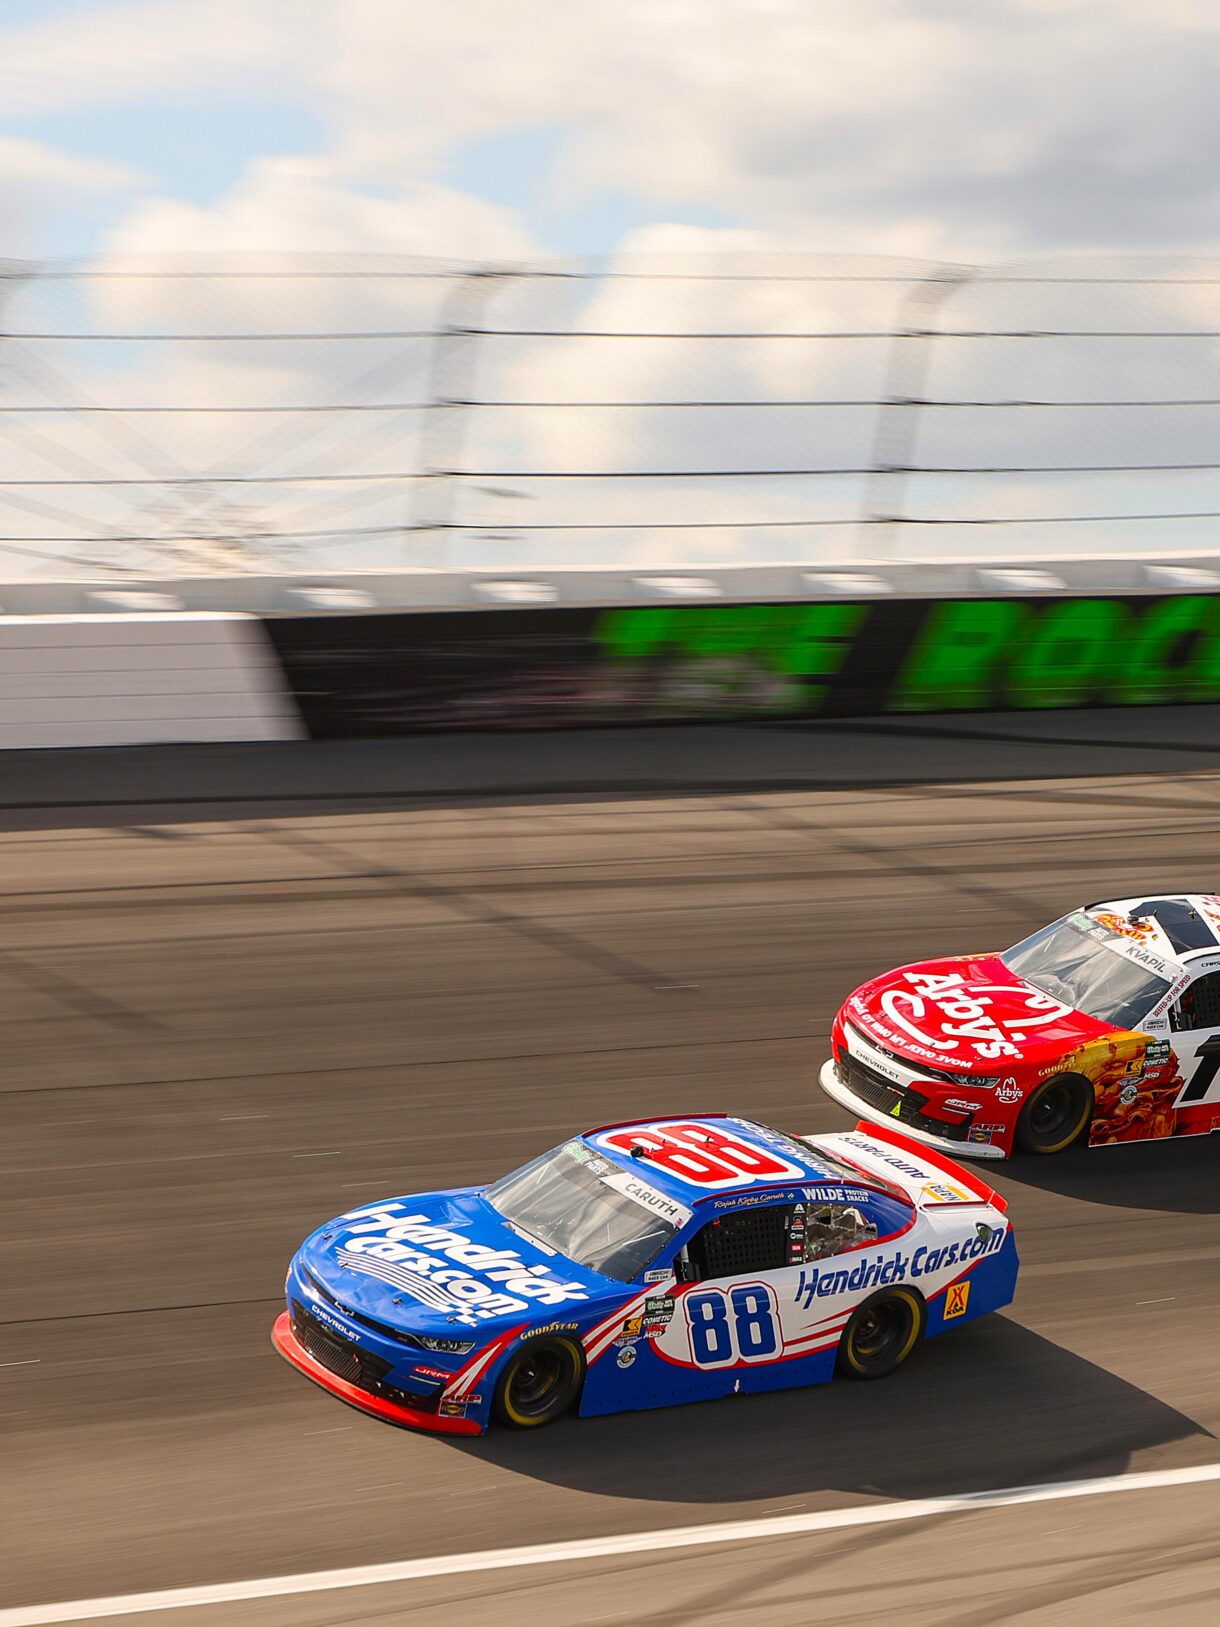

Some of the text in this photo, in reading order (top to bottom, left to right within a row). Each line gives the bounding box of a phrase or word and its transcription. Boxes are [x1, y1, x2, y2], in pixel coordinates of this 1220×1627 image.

[1129, 899, 1220, 956] 1
[1126, 946, 1167, 973] KVAPIL
[902, 971, 1027, 1059] Arby's
[855, 1049, 901, 1080] CHEVROLET
[994, 1087, 1024, 1098] Arby's
[603, 1123, 791, 1184] 88
[838, 1136, 962, 1201] NAPA AUTO PARTS
[624, 1183, 679, 1216] CARUTH
[801, 1188, 846, 1201] WILDE
[845, 1189, 869, 1197] PROTEIN
[845, 1195, 869, 1203] SNACKS
[340, 1202, 590, 1305] Hendrick
[794, 1227, 1006, 1310] Hendrick Cars.com
[344, 1236, 529, 1317] Cars.com
[311, 1304, 361, 1341] CHEVROLET
[686, 1285, 777, 1365] 88
[945, 1305, 965, 1317] KOA
[519, 1320, 579, 1341] GOODYEAR
[415, 1367, 450, 1380] JRM
